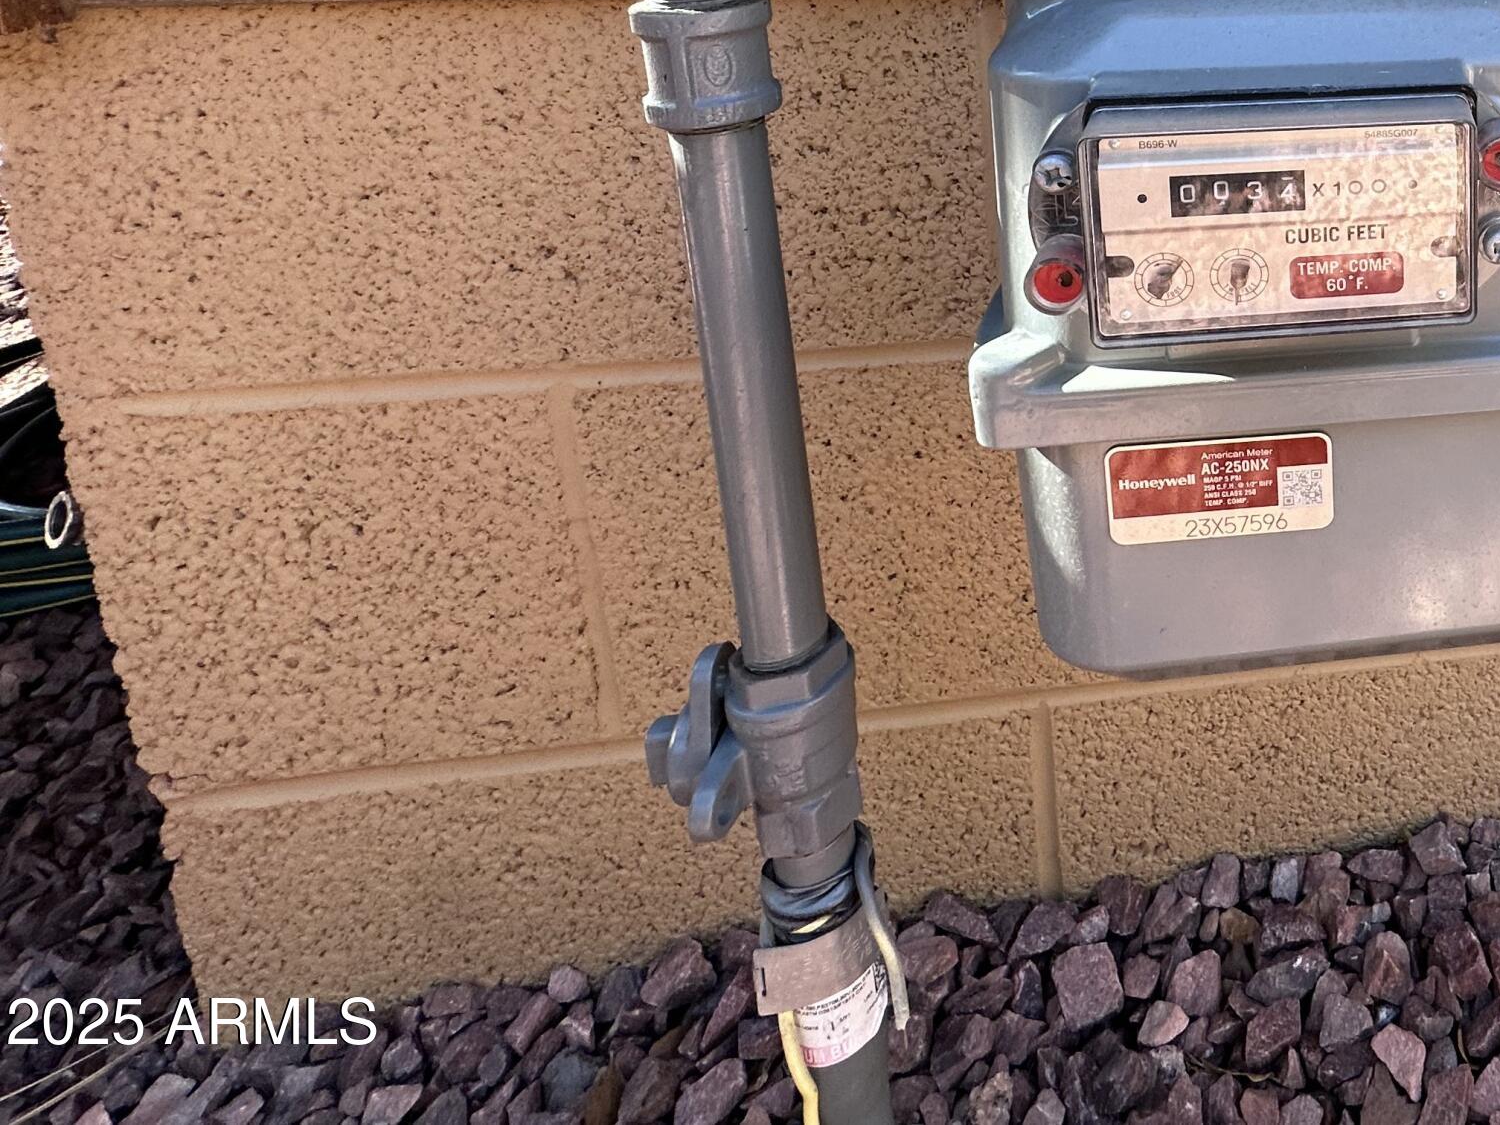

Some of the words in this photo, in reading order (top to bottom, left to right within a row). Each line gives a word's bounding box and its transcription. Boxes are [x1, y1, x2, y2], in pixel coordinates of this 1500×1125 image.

[1138, 140, 1178, 150] B696-W
[1285, 226, 1340, 244] CUBIC
[1347, 224, 1388, 241] FEET
[1297, 260, 1344, 276] TEMP.
[1349, 257, 1396, 273] COMP.
[1201, 452, 1245, 460] American
[1246, 448, 1274, 457] Meter
[1201, 458, 1269, 475] AC-250NX
[1118, 474, 1196, 490] Honeywell
[1185, 513, 1288, 537] 23X57596
